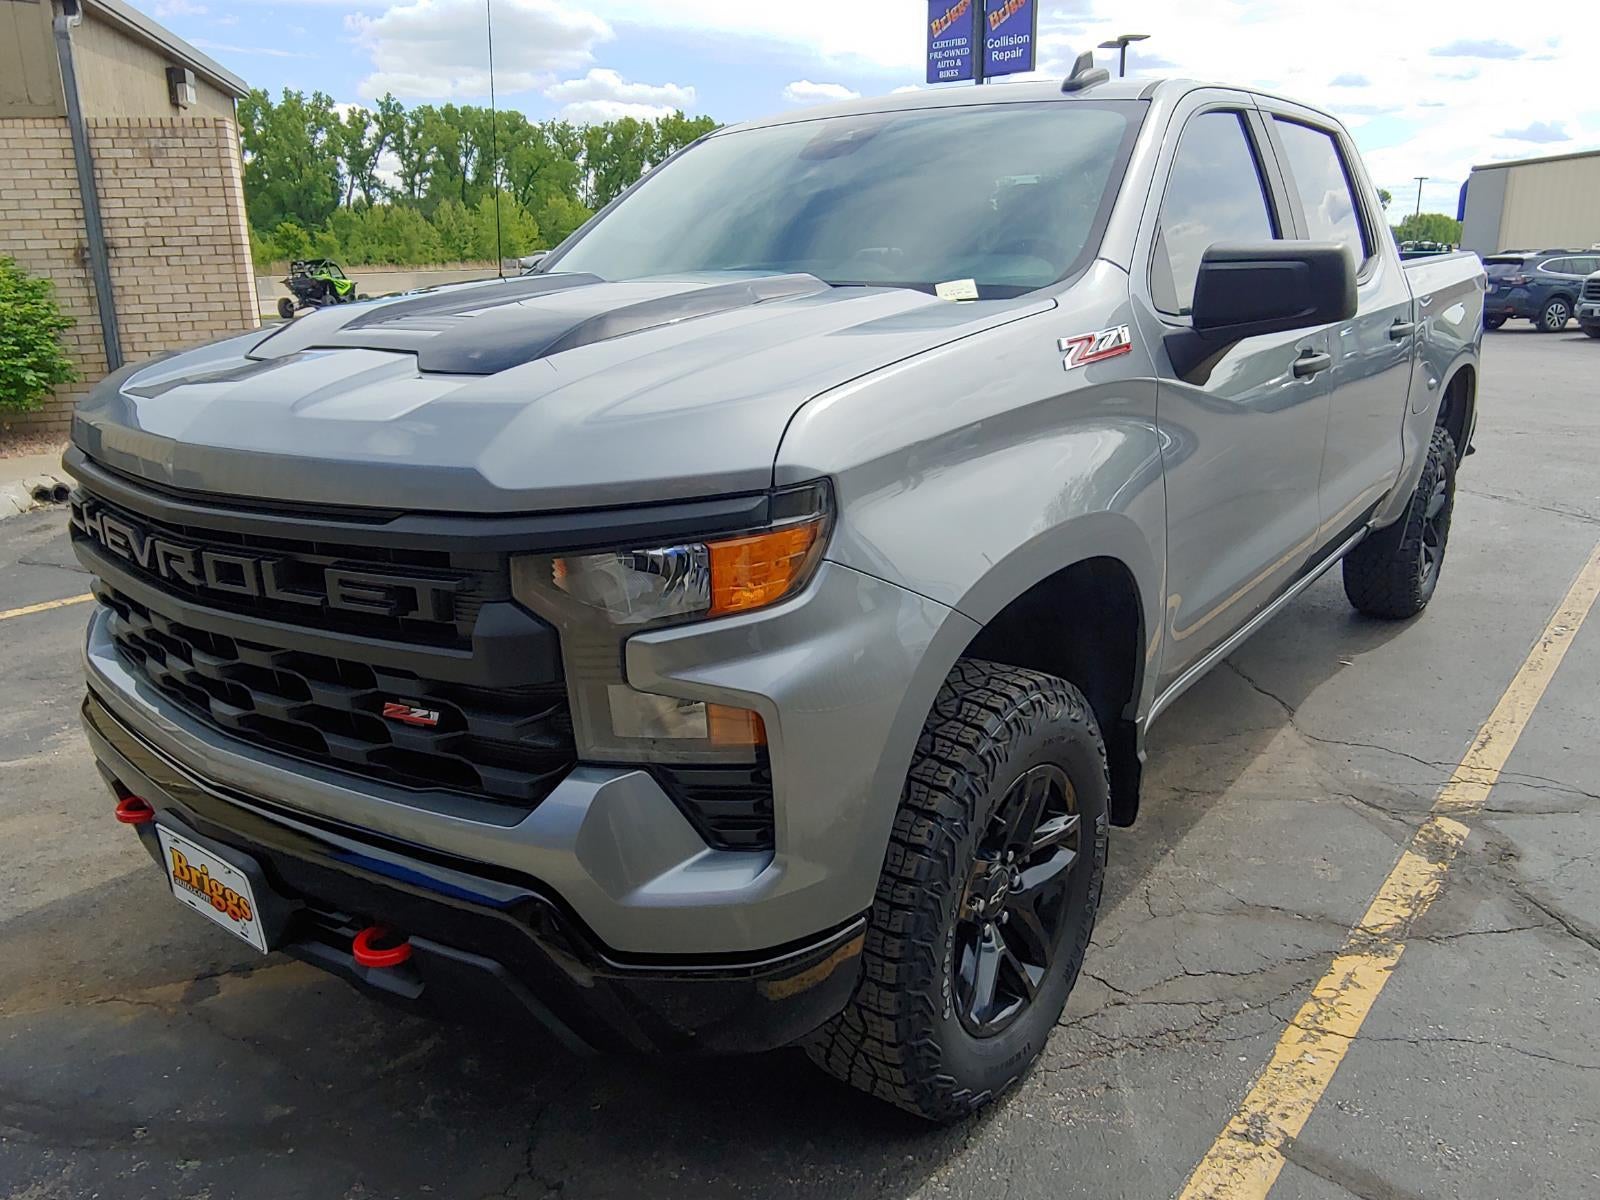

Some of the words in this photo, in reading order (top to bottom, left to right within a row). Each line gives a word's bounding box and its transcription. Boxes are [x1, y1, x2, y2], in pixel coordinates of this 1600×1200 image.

[932, 37, 967, 49] CERTIFIED
[987, 33, 1030, 49] Collision
[929, 47, 970, 59] PRE-OWNED
[991, 47, 1023, 61] Repair
[937, 59, 956, 69] AUTO
[956, 58, 962, 67] &
[939, 69, 959, 79] BIKES
[1057, 323, 1133, 371] Z71
[71, 498, 467, 621] CHEVROLET
[382, 702, 440, 726] Z71
[169, 846, 253, 922] Briggs
